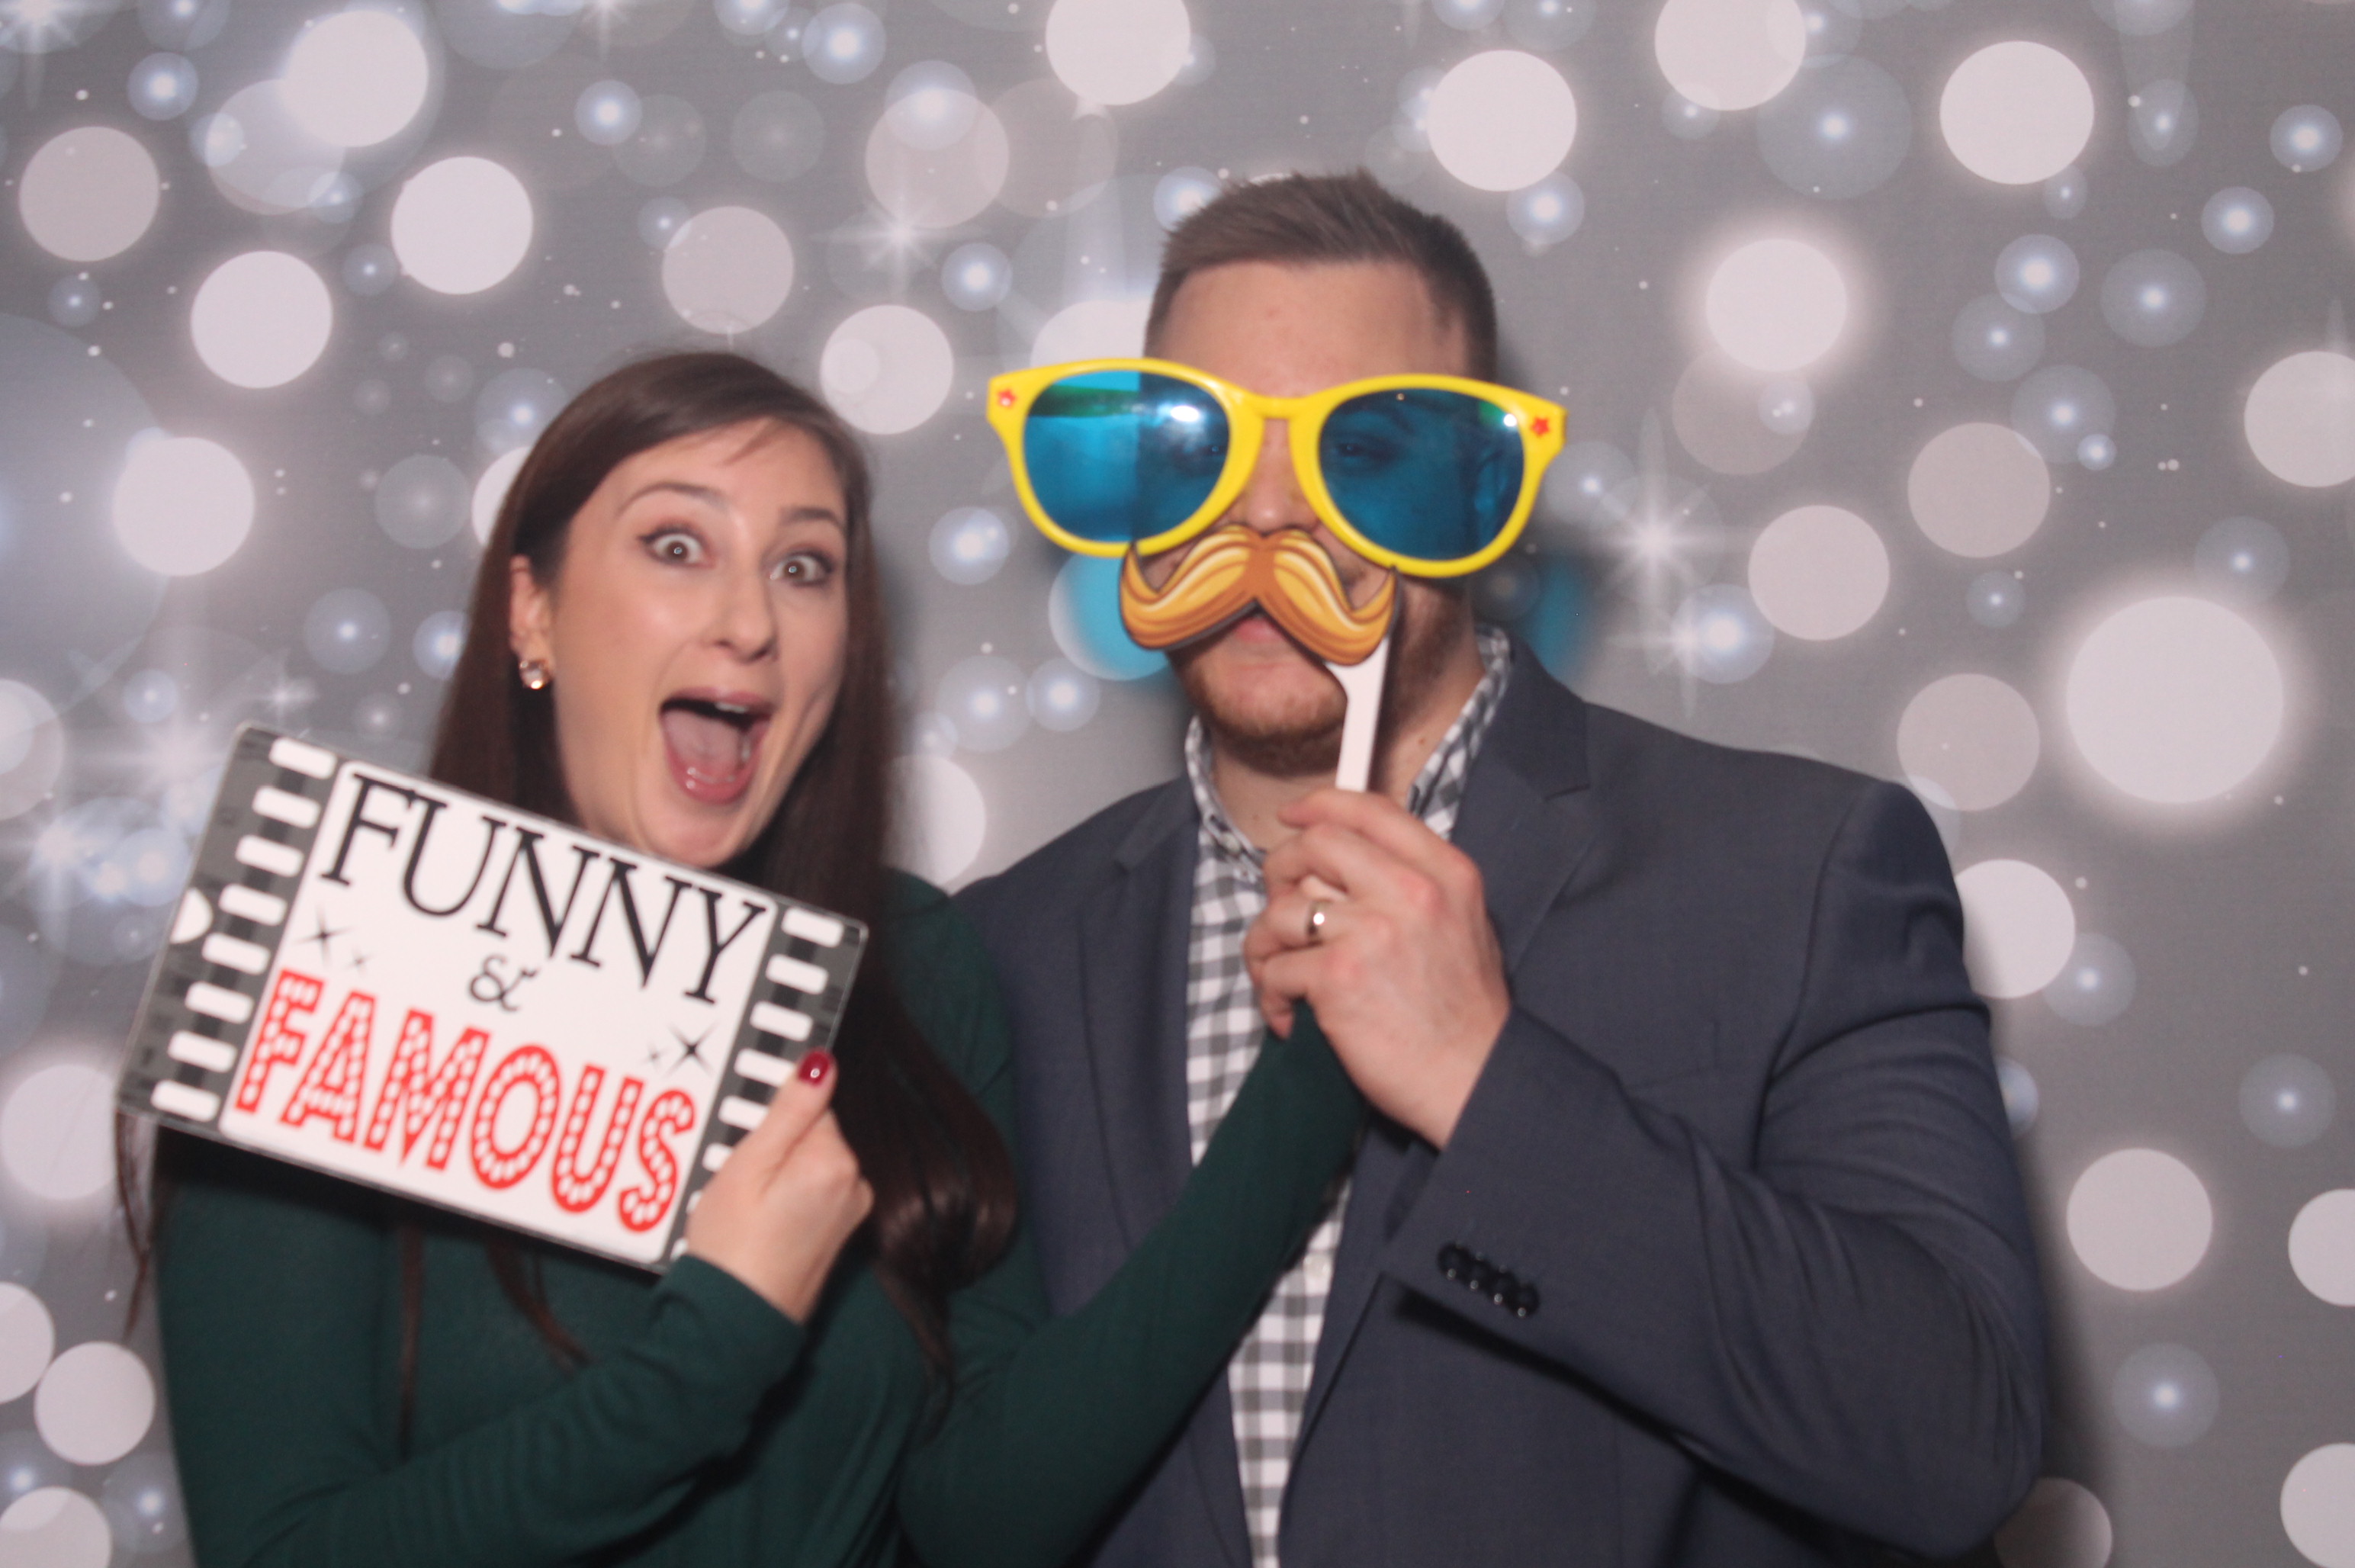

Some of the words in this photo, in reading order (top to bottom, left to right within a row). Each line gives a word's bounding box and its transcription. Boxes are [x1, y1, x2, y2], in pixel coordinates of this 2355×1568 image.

[320, 773, 766, 1004] FUNNY
[468, 954, 538, 1011] &
[235, 968, 696, 1232] FAMOUS
